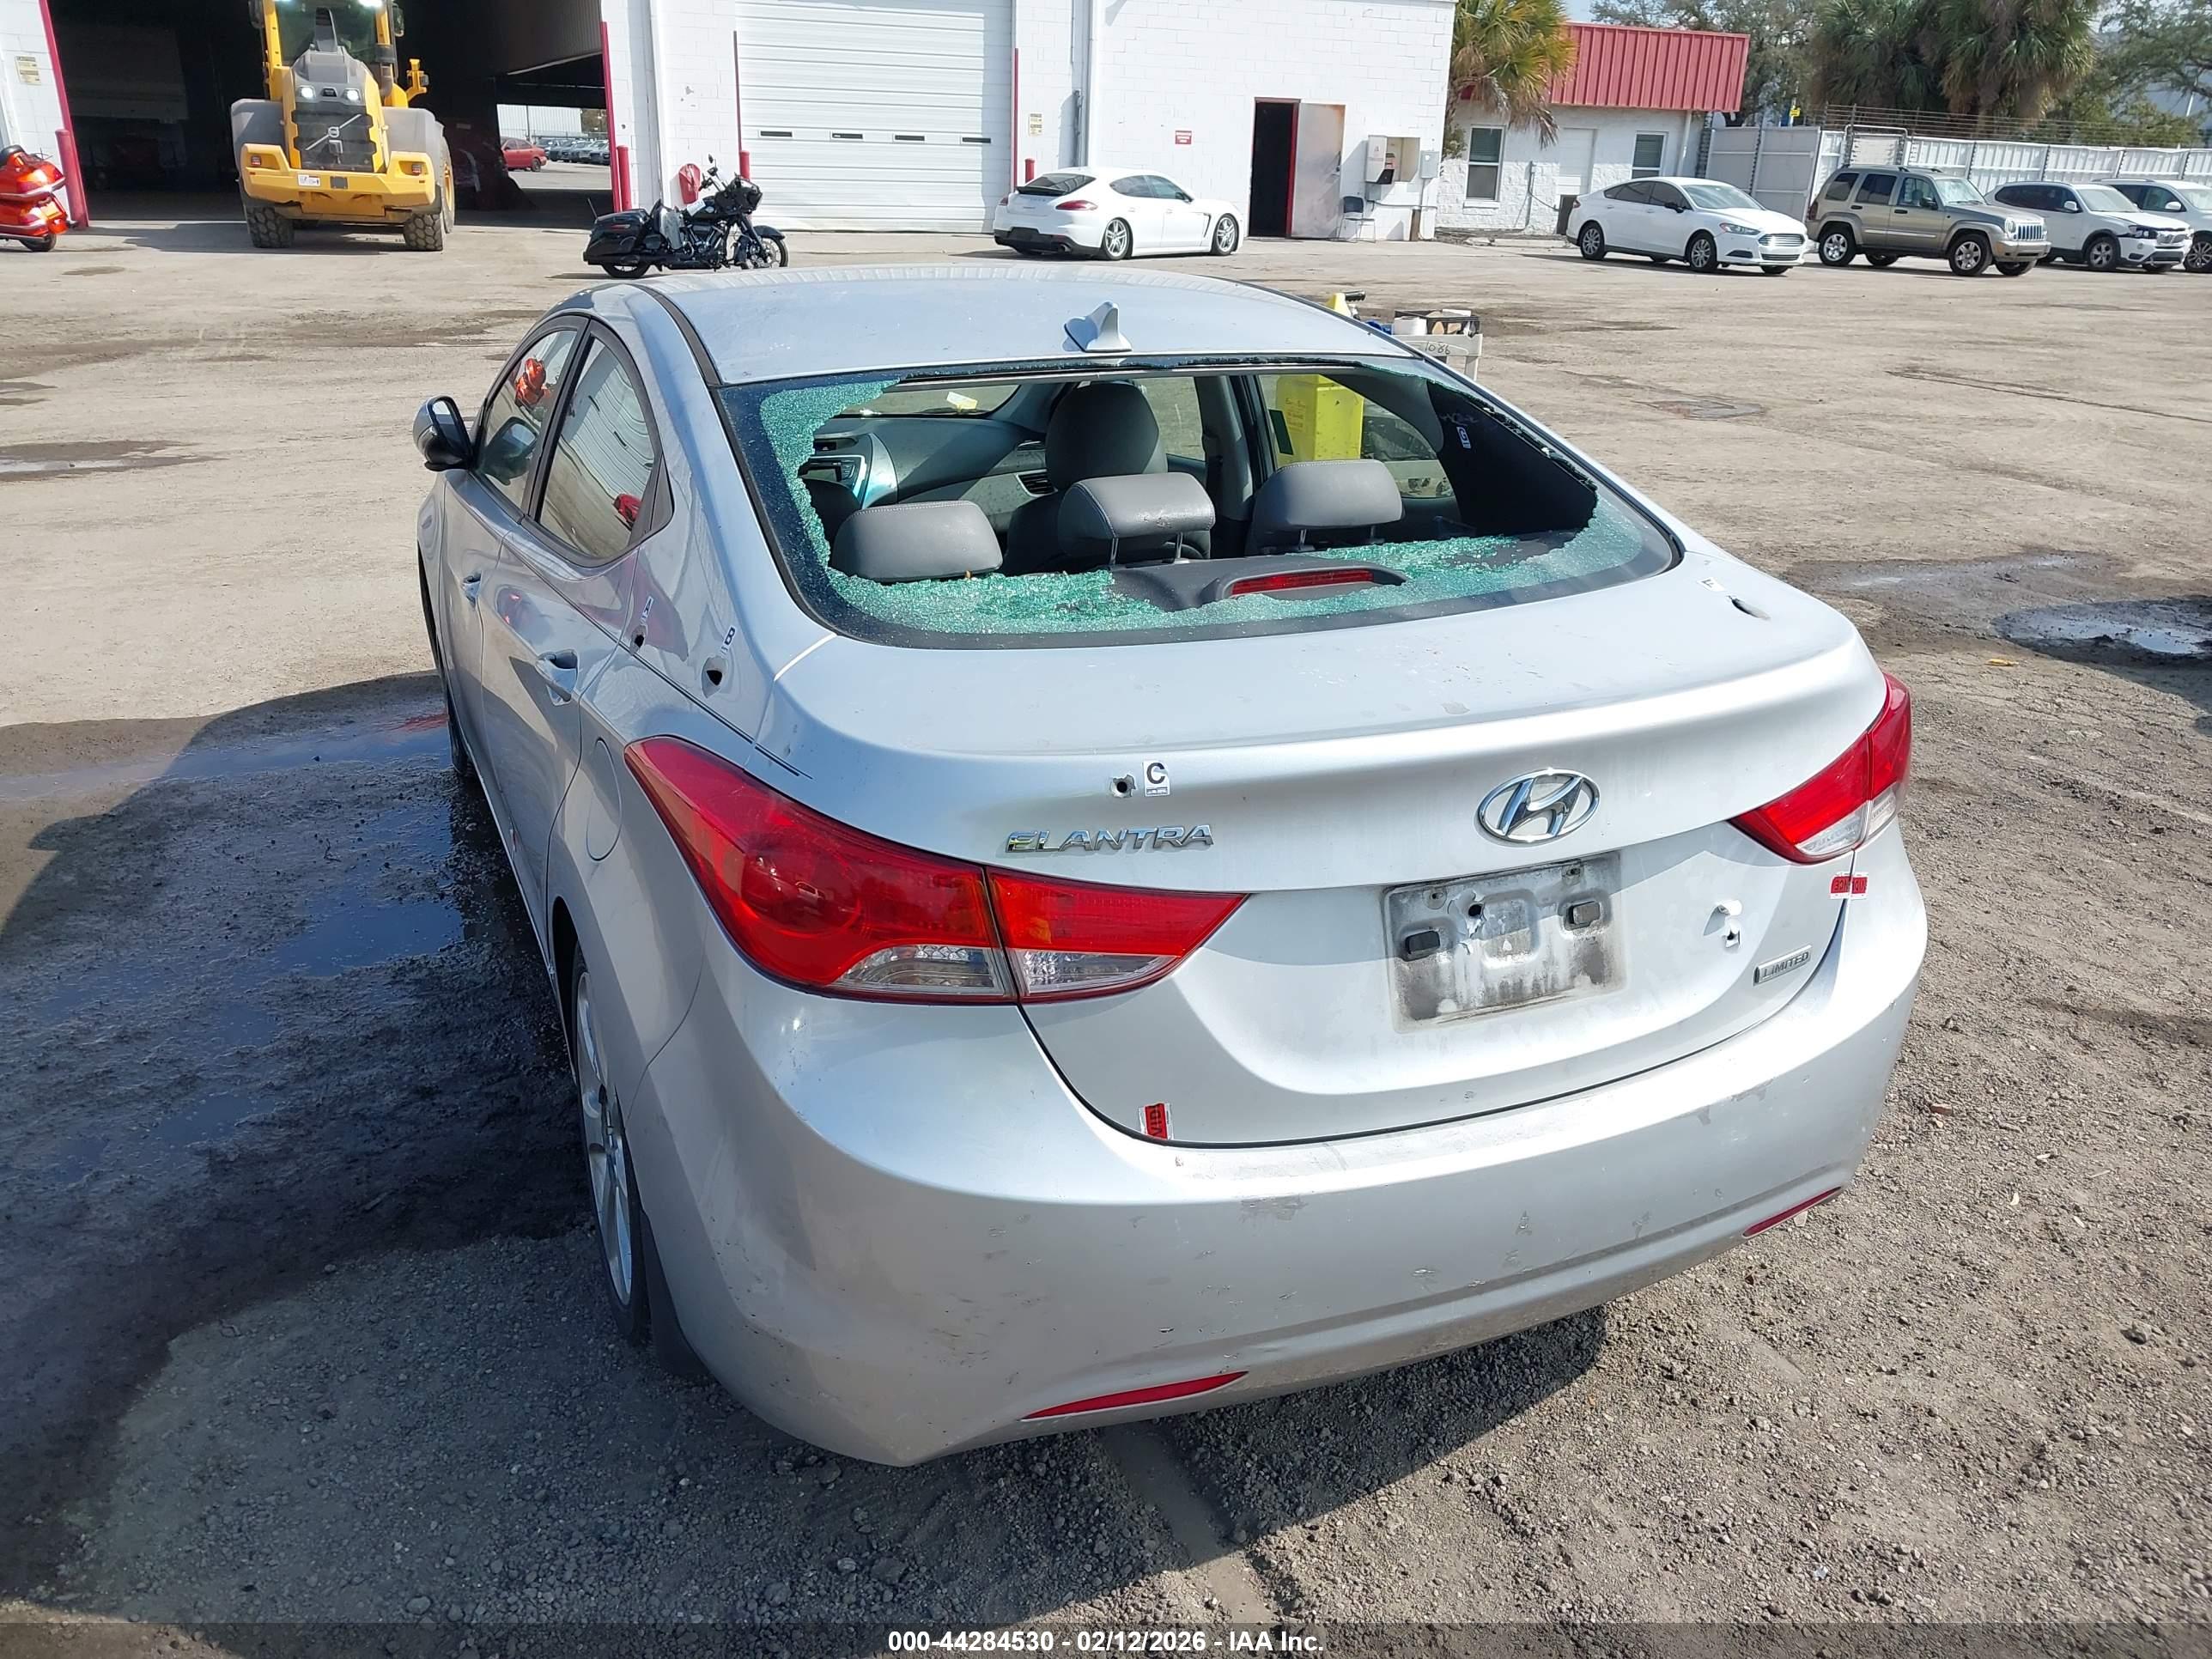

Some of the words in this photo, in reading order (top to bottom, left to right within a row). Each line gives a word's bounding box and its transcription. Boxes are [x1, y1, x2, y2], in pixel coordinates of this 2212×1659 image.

[724, 627, 736, 646] B
[1146, 762, 1166, 785] C
[1005, 823, 1214, 853] ELANTRA
[1761, 951, 1810, 978] LIMITED
